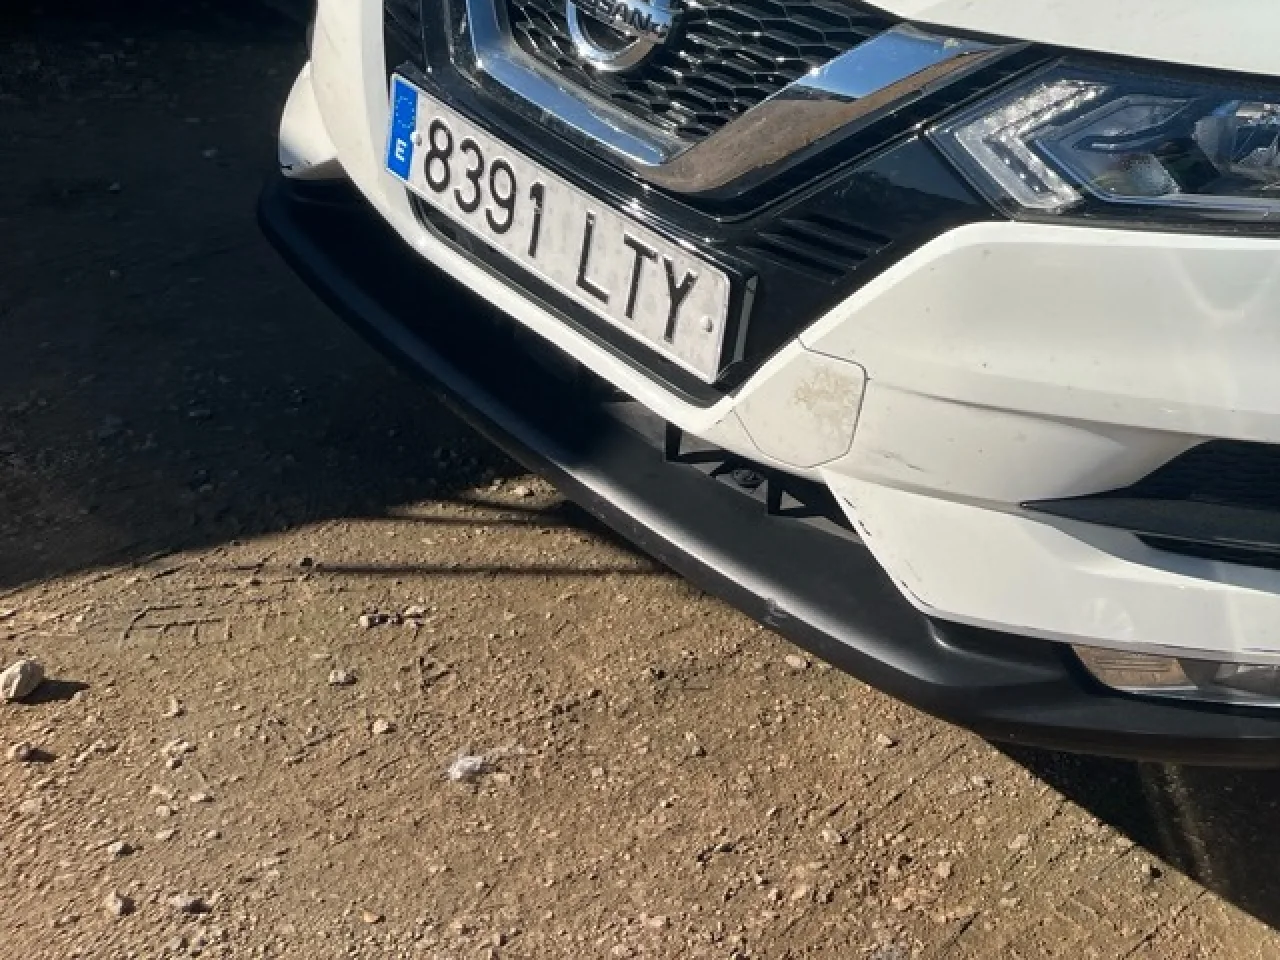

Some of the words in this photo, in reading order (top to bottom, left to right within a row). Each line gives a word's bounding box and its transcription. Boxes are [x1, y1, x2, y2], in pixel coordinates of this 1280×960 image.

[395, 137, 407, 162] E
[423, 118, 546, 259] 8391
[575, 211, 698, 342] LTY
